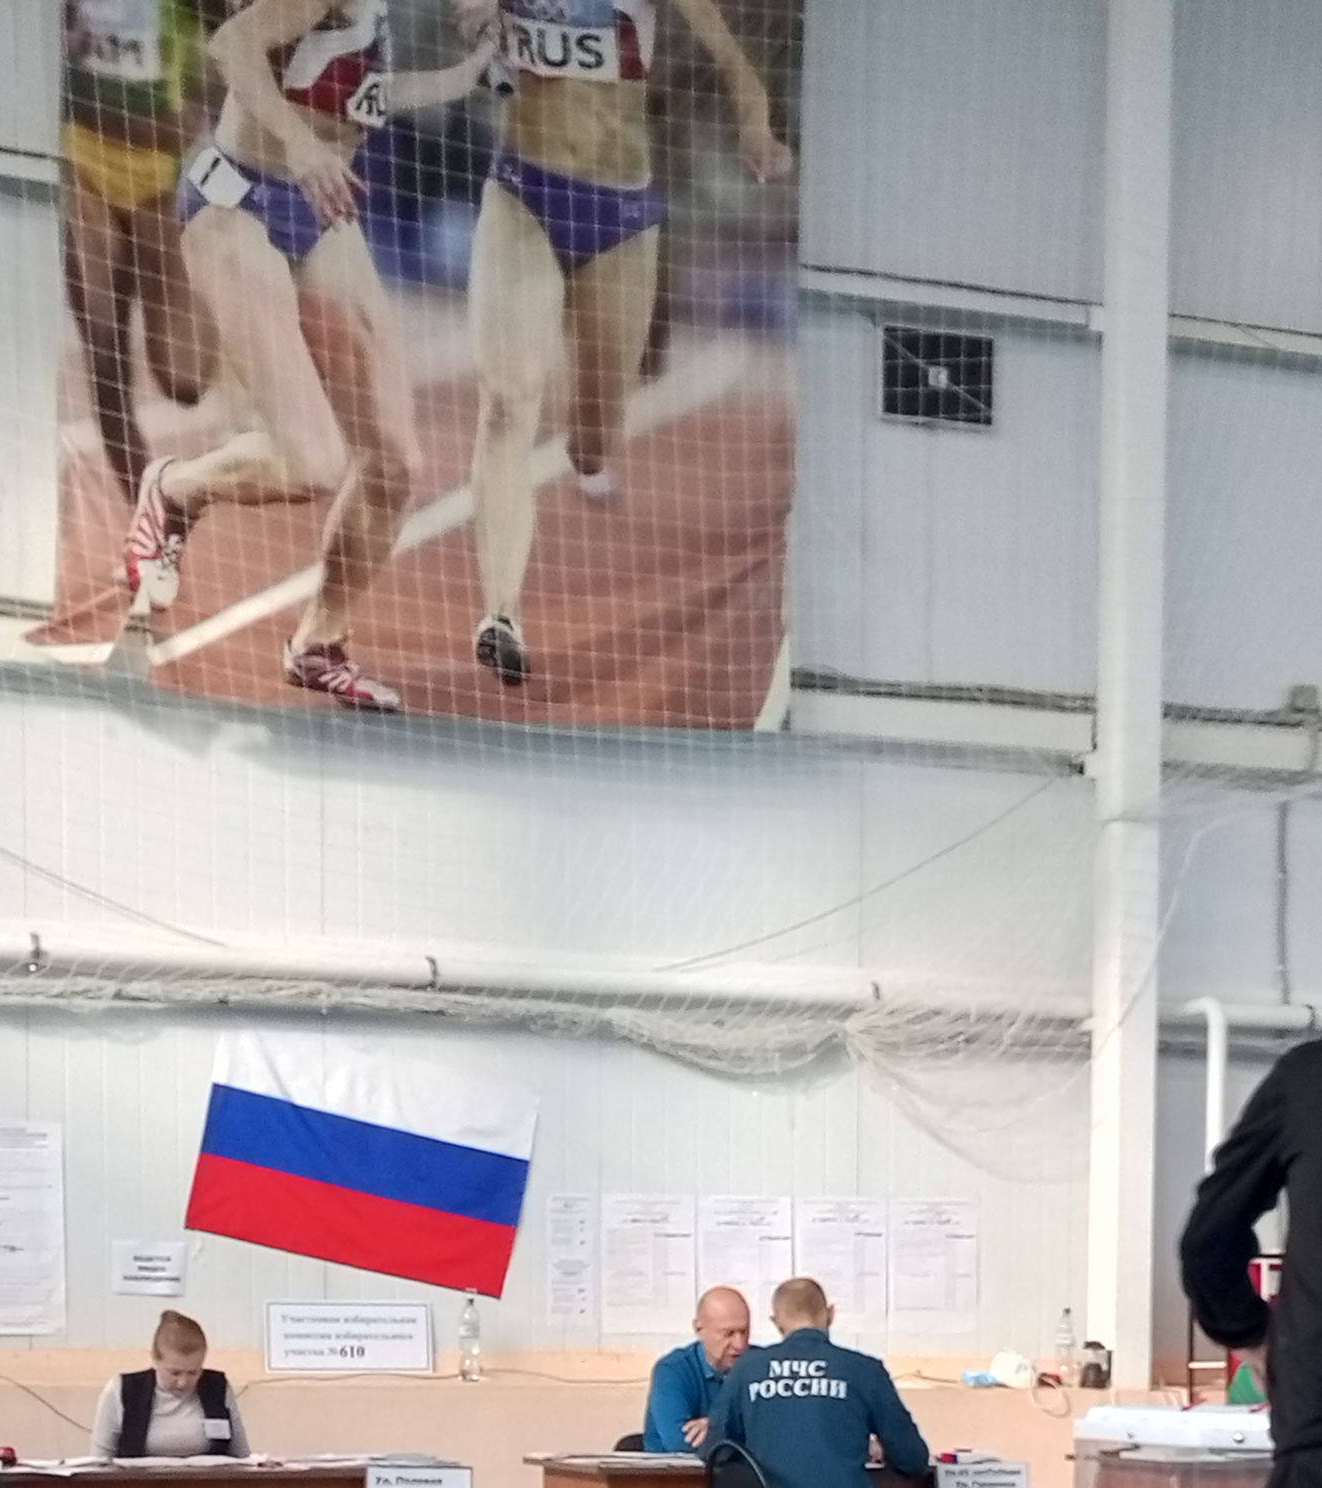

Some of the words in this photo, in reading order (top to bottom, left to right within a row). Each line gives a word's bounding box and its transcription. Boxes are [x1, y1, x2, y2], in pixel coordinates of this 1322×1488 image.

[513, 24, 604, 69] RUS
[769, 1360, 828, 1377] МЧС
[748, 1378, 847, 1402] РОССИИ
